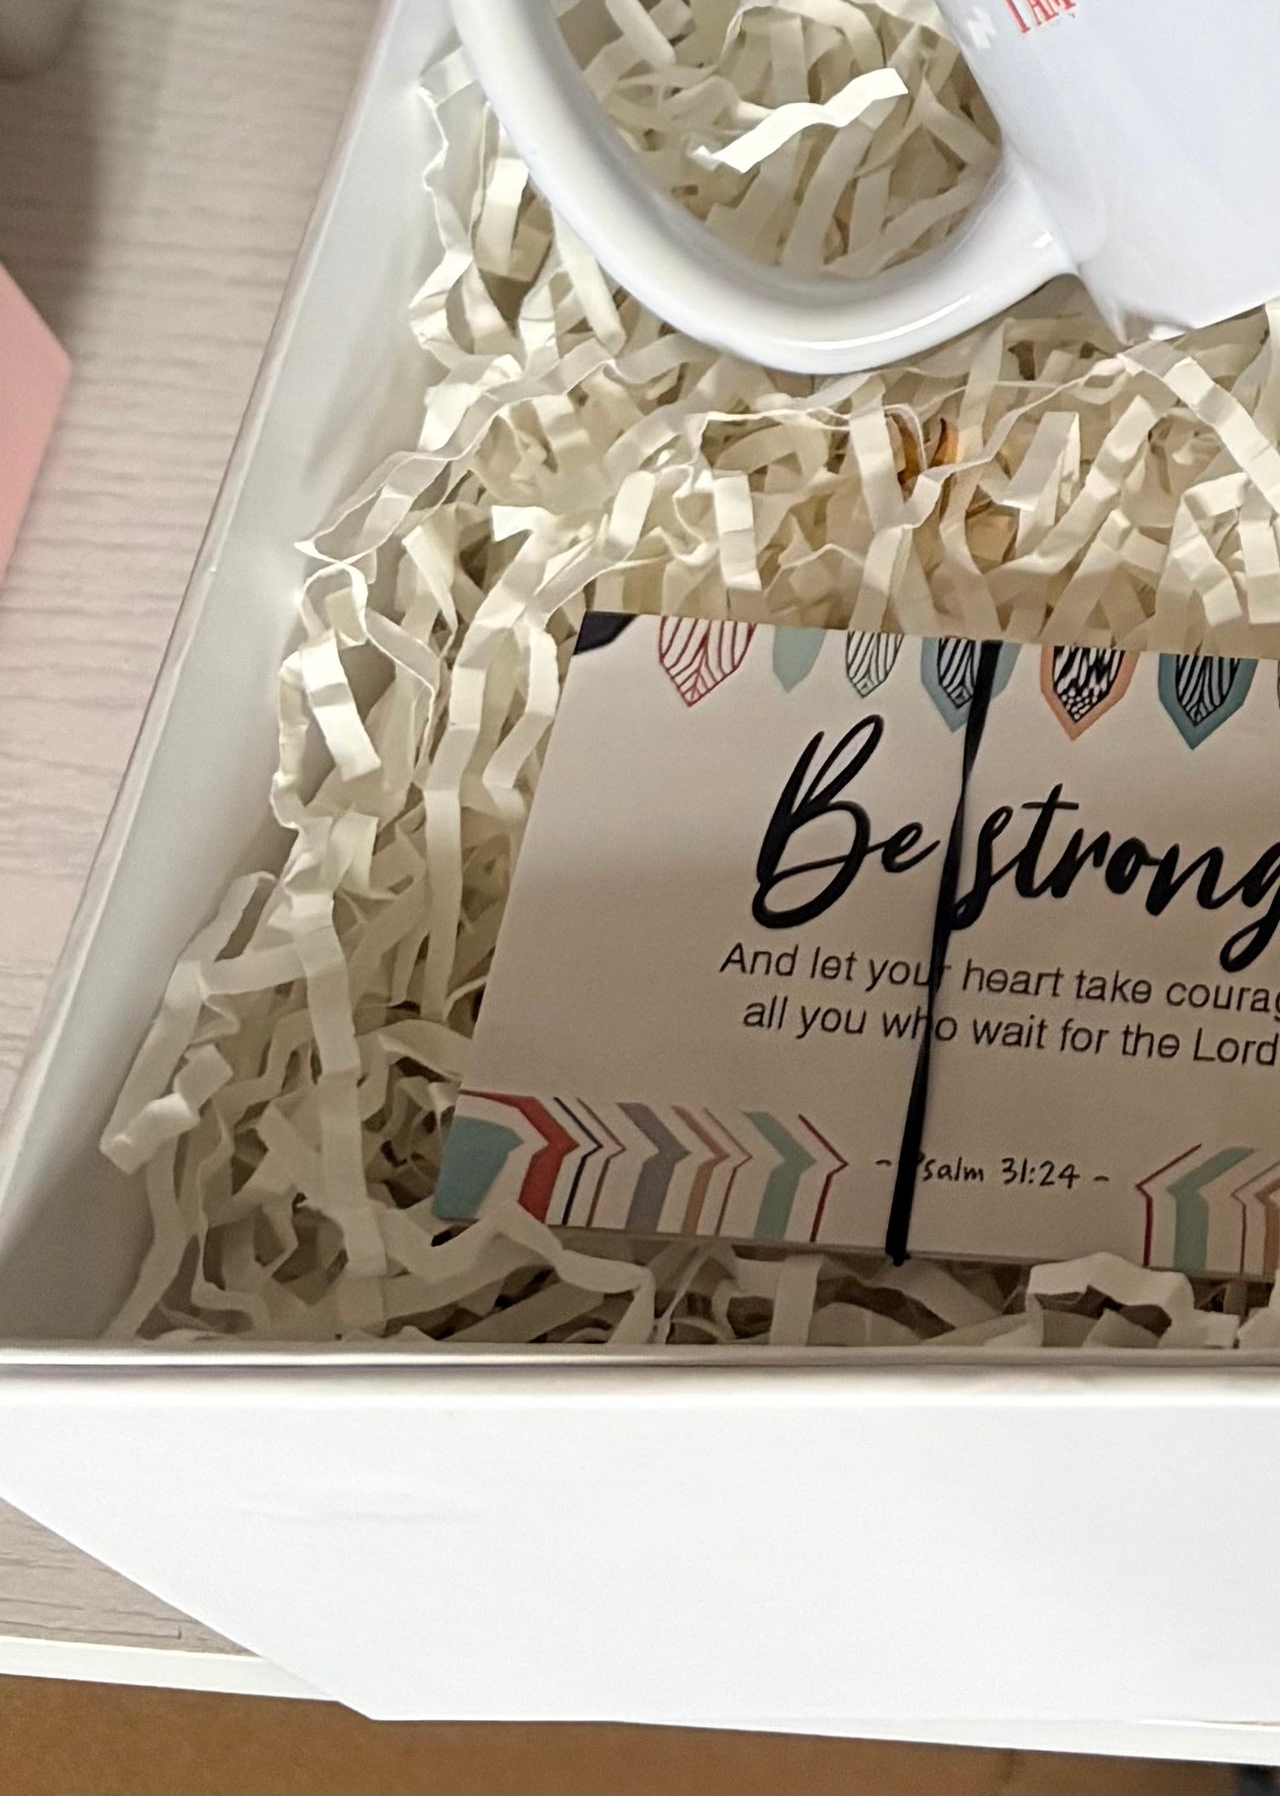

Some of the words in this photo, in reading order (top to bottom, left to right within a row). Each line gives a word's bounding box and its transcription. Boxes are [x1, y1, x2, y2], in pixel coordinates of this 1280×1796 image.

[751, 713, 941, 930] Be
[718, 941, 799, 977] And
[810, 945, 859, 982] let
[864, 957, 952, 993] you
[961, 957, 1064, 1001] heart
[1075, 968, 1152, 1005] take
[742, 994, 789, 1030] all
[795, 1004, 868, 1040] you
[882, 1004, 958, 1043] who
[972, 1012, 1049, 1050] wait
[1059, 1016, 1110, 1055] for
[1121, 1023, 1181, 1059] the
[915, 1150, 985, 1183] salm
[1000, 1156, 1081, 1190] 31:24
